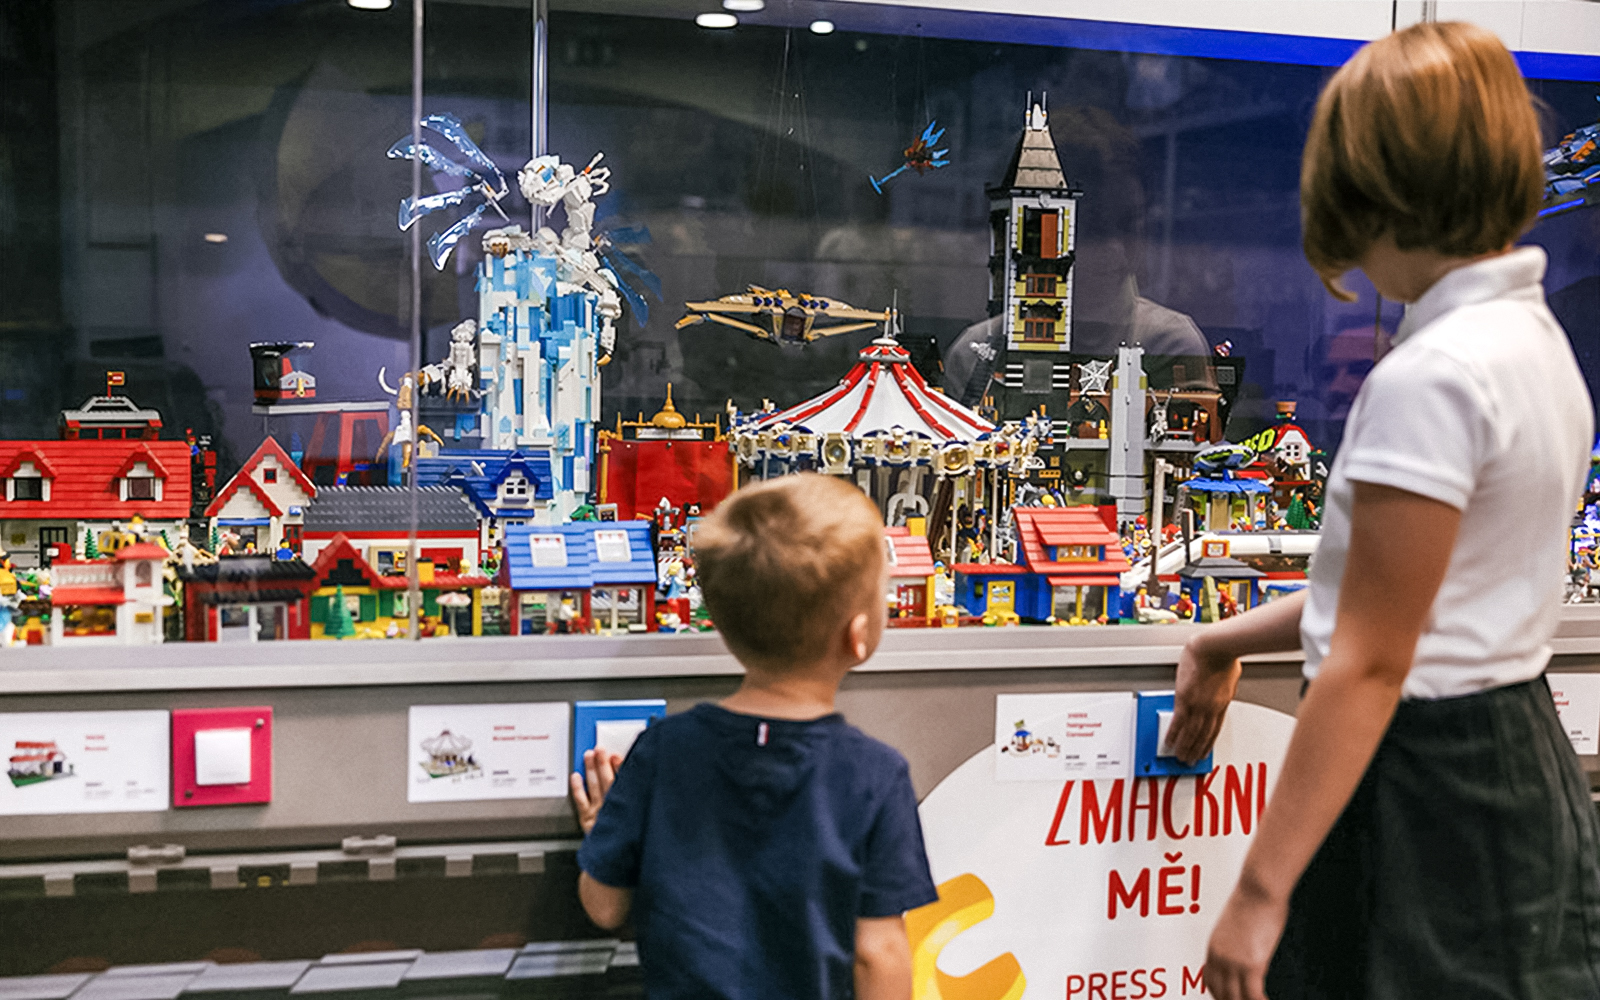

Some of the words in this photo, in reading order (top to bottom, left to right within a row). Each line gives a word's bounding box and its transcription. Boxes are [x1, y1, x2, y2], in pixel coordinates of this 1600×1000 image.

[1107, 851, 1201, 920] MĚ!
[1066, 967, 1167, 1000] PRESS
[1181, 965, 1208, 996] M
